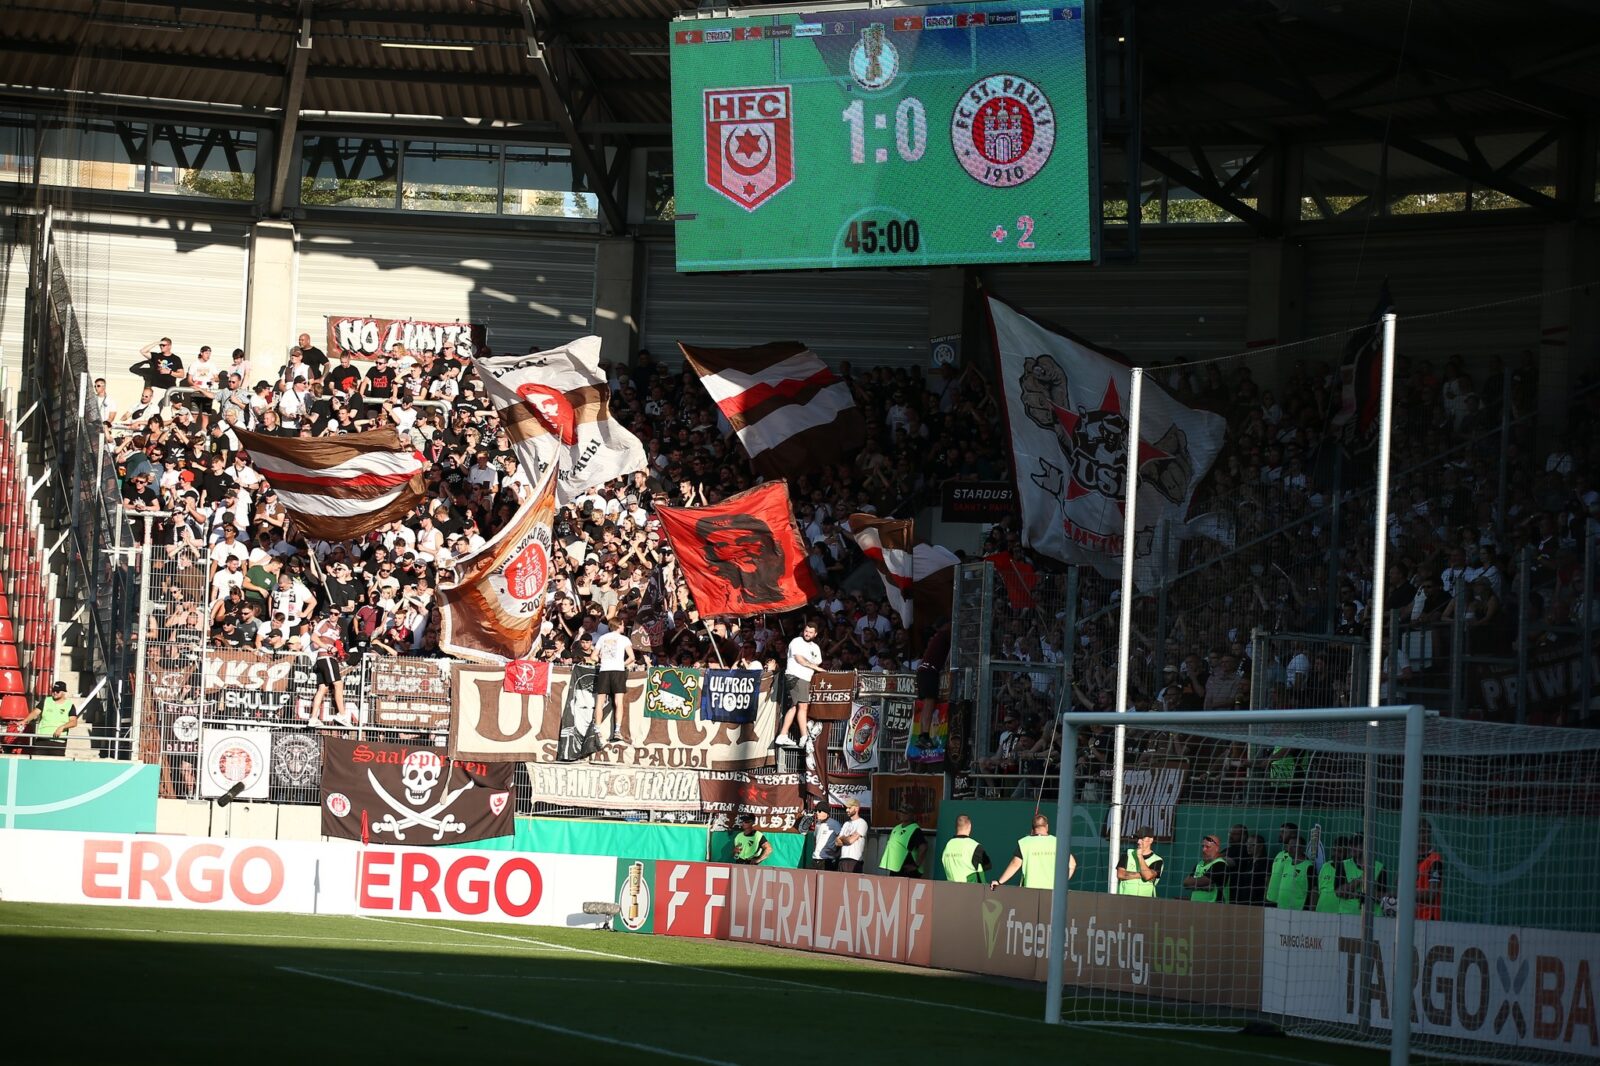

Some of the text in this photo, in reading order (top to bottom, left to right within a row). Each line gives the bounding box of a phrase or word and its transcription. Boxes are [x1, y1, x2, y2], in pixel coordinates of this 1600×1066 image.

[711, 94, 782, 120] HFC
[955, 79, 1053, 130] FC ST. PAULI
[841, 97, 928, 164] 1:0
[983, 165, 1024, 184] 1910
[843, 219, 920, 255] 45:00
[338, 319, 472, 358] NO LIMITS
[953, 488, 1014, 500] STARDUST
[205, 656, 291, 691] KKSP
[709, 675, 755, 693] ULTRAS
[542, 742, 708, 769] SKT PAULI
[535, 766, 610, 799] ENFANTS
[699, 770, 751, 784] WILDER
[81, 839, 285, 905] ERGO
[359, 850, 544, 918] ERGO
[703, 865, 902, 959] FLYERALARM
[1006, 908, 1195, 986] freet, fertig, los!
